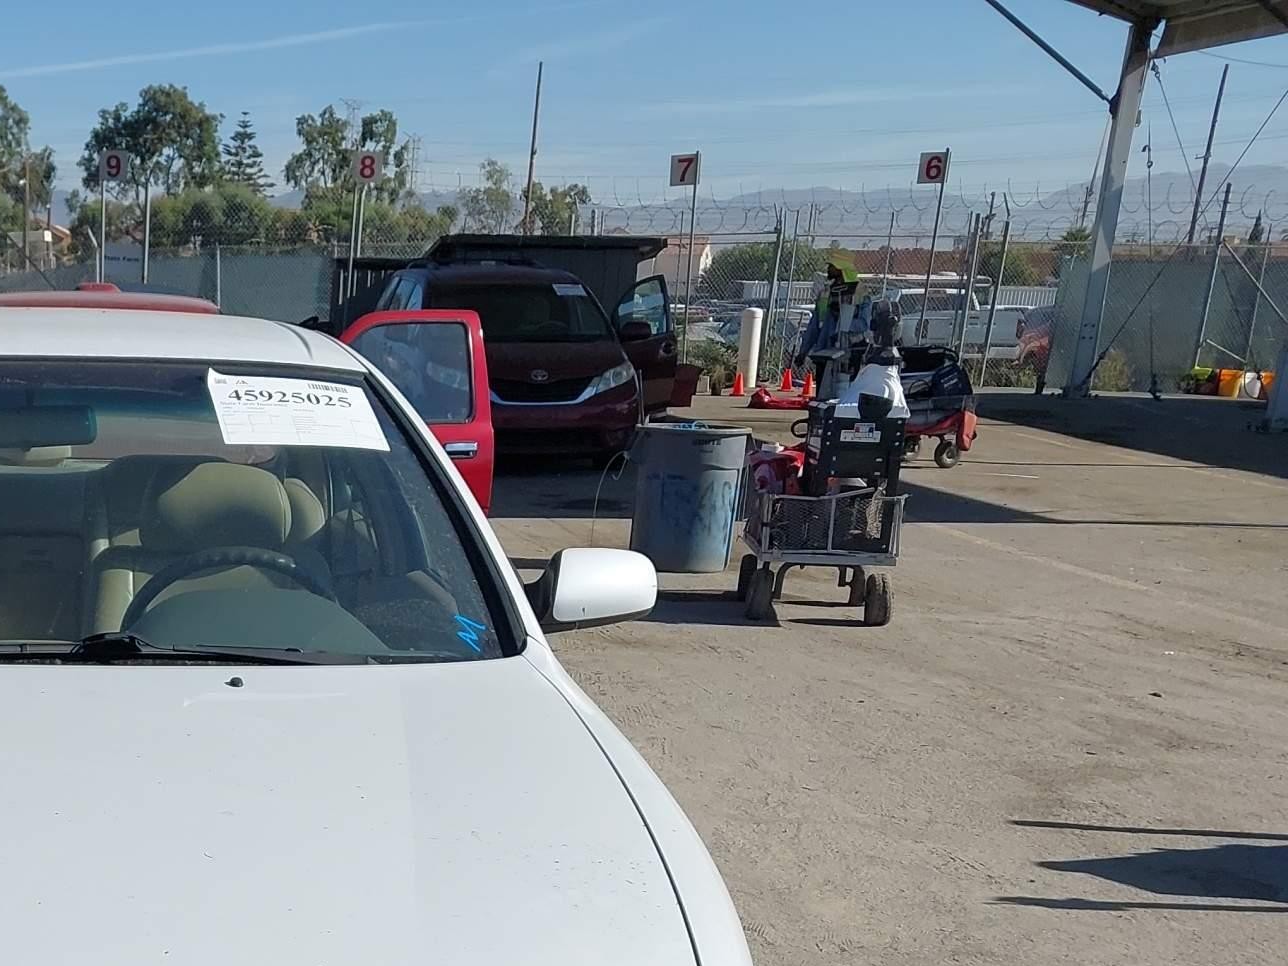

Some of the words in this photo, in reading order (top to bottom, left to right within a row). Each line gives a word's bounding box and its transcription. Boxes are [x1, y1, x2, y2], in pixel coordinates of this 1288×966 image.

[106, 155, 121, 178] 9
[359, 155, 376, 179] 8
[677, 157, 695, 182] 7
[925, 155, 943, 181] 6
[228, 389, 353, 408] 45925025
